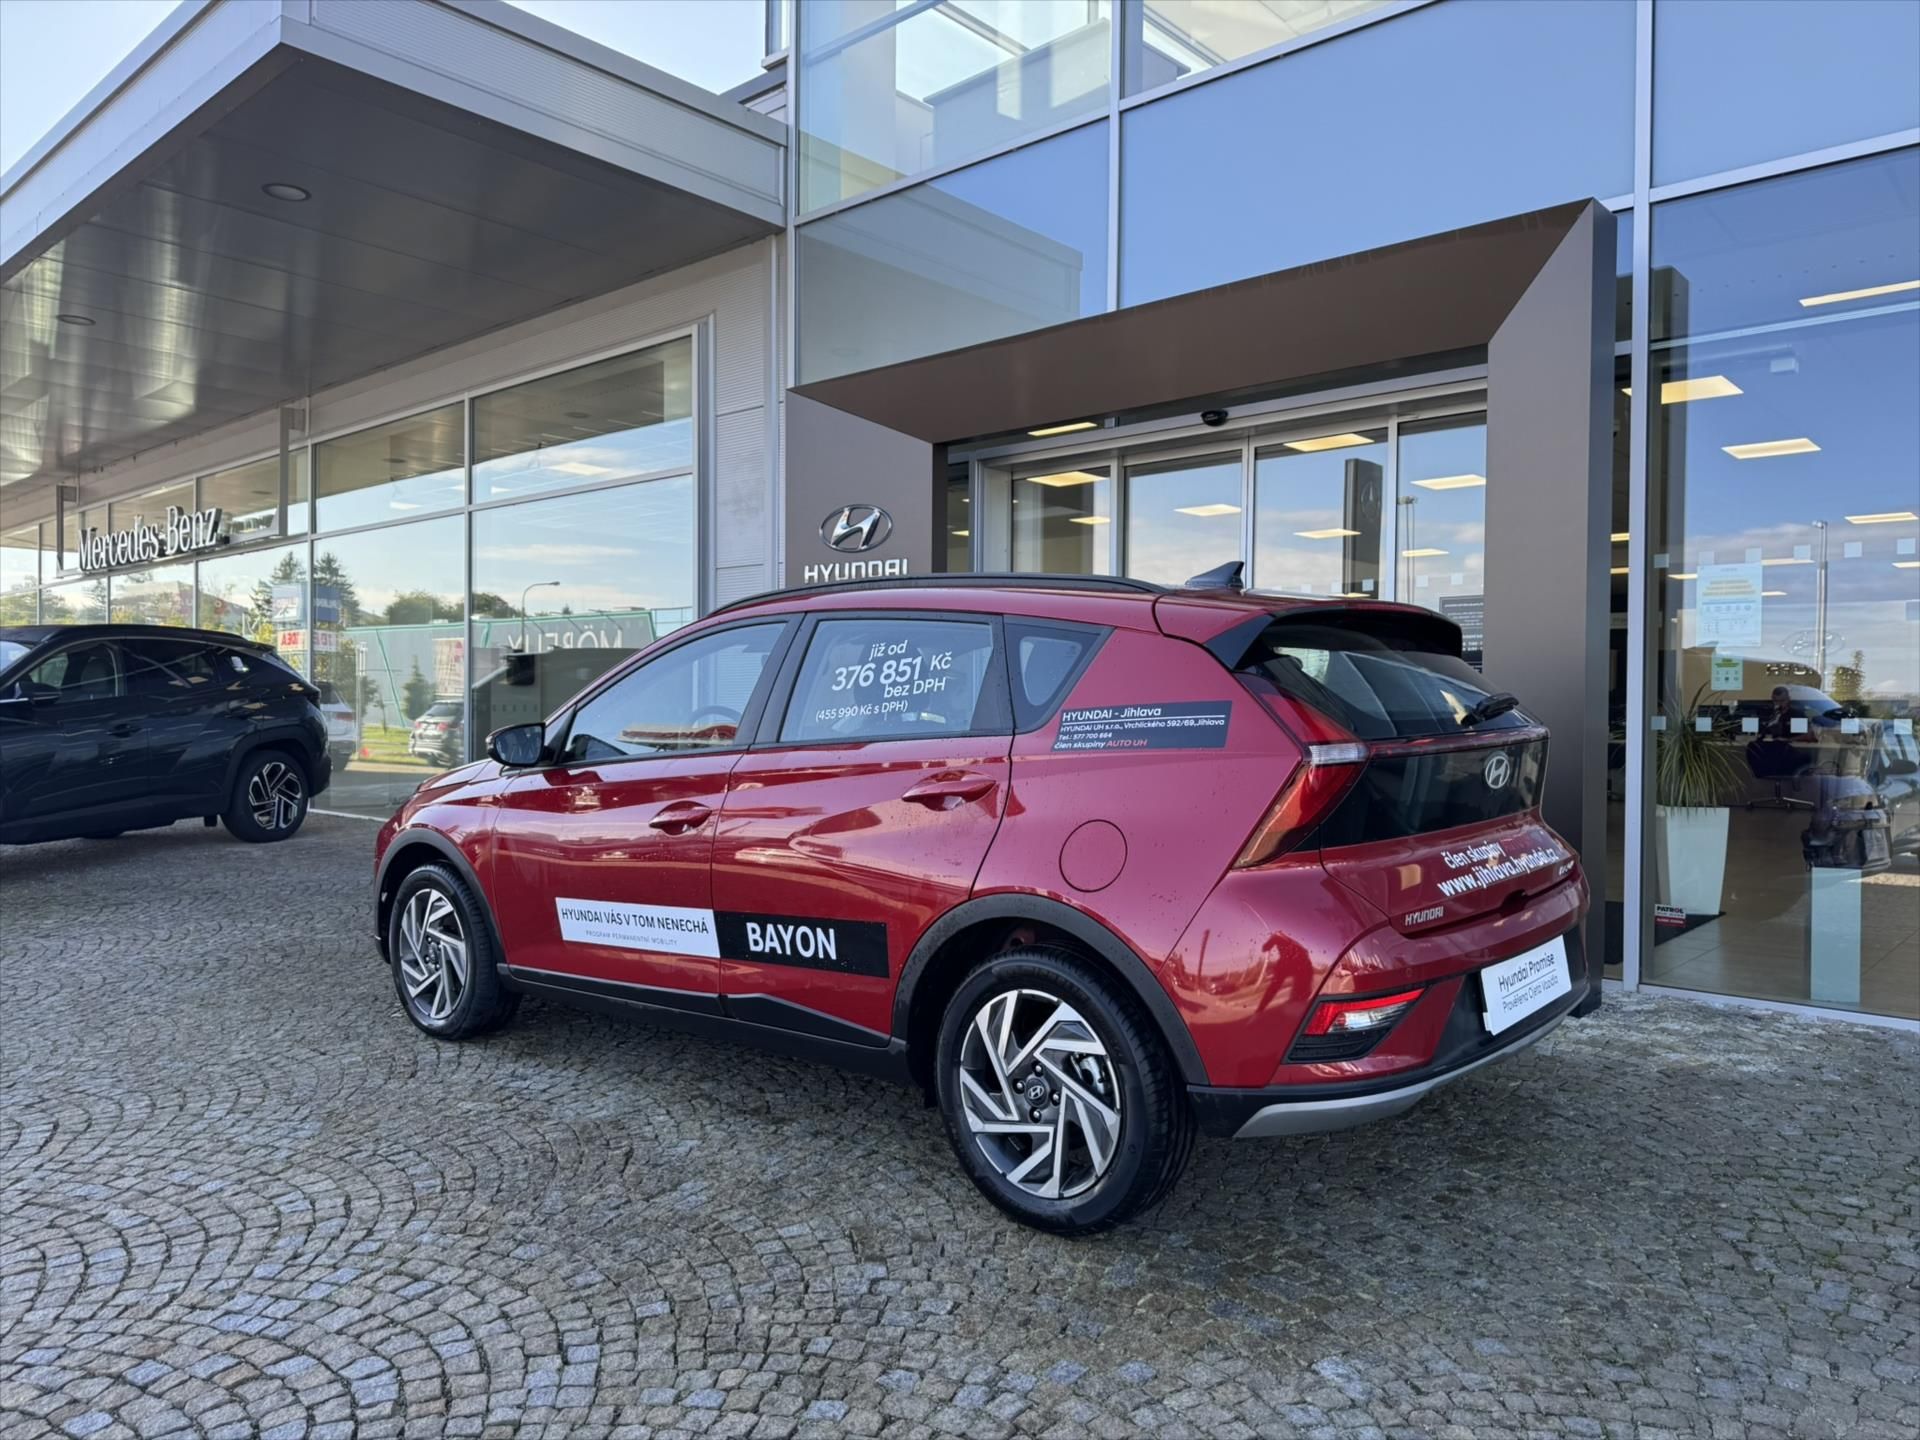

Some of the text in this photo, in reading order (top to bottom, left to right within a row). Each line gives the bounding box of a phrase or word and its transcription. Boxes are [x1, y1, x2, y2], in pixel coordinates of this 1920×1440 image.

[79, 505, 219, 571] Mercedes-Benz
[804, 558, 908, 583] HYUNDAI
[868, 640, 909, 661] již od
[831, 652, 953, 691] 376 851 Kč
[884, 677, 946, 698] bez DPH
[815, 700, 908, 723] (455 990 Kč s DPH)
[1062, 709, 1113, 722] HYUNDAI
[1120, 706, 1162, 718] Jihlava
[1060, 724, 1093, 733] HYUNDAI
[1073, 740, 1106, 749] skupiny
[1133, 739, 1148, 747] UH
[1441, 846, 1471, 869] člen
[561, 908, 709, 934] HYUNDAI VÁS V TOM NENECHÁ
[1405, 906, 1444, 926] HYUNDAI
[746, 922, 837, 960] BAYON
[1498, 952, 1555, 992] Hyundai Promise
